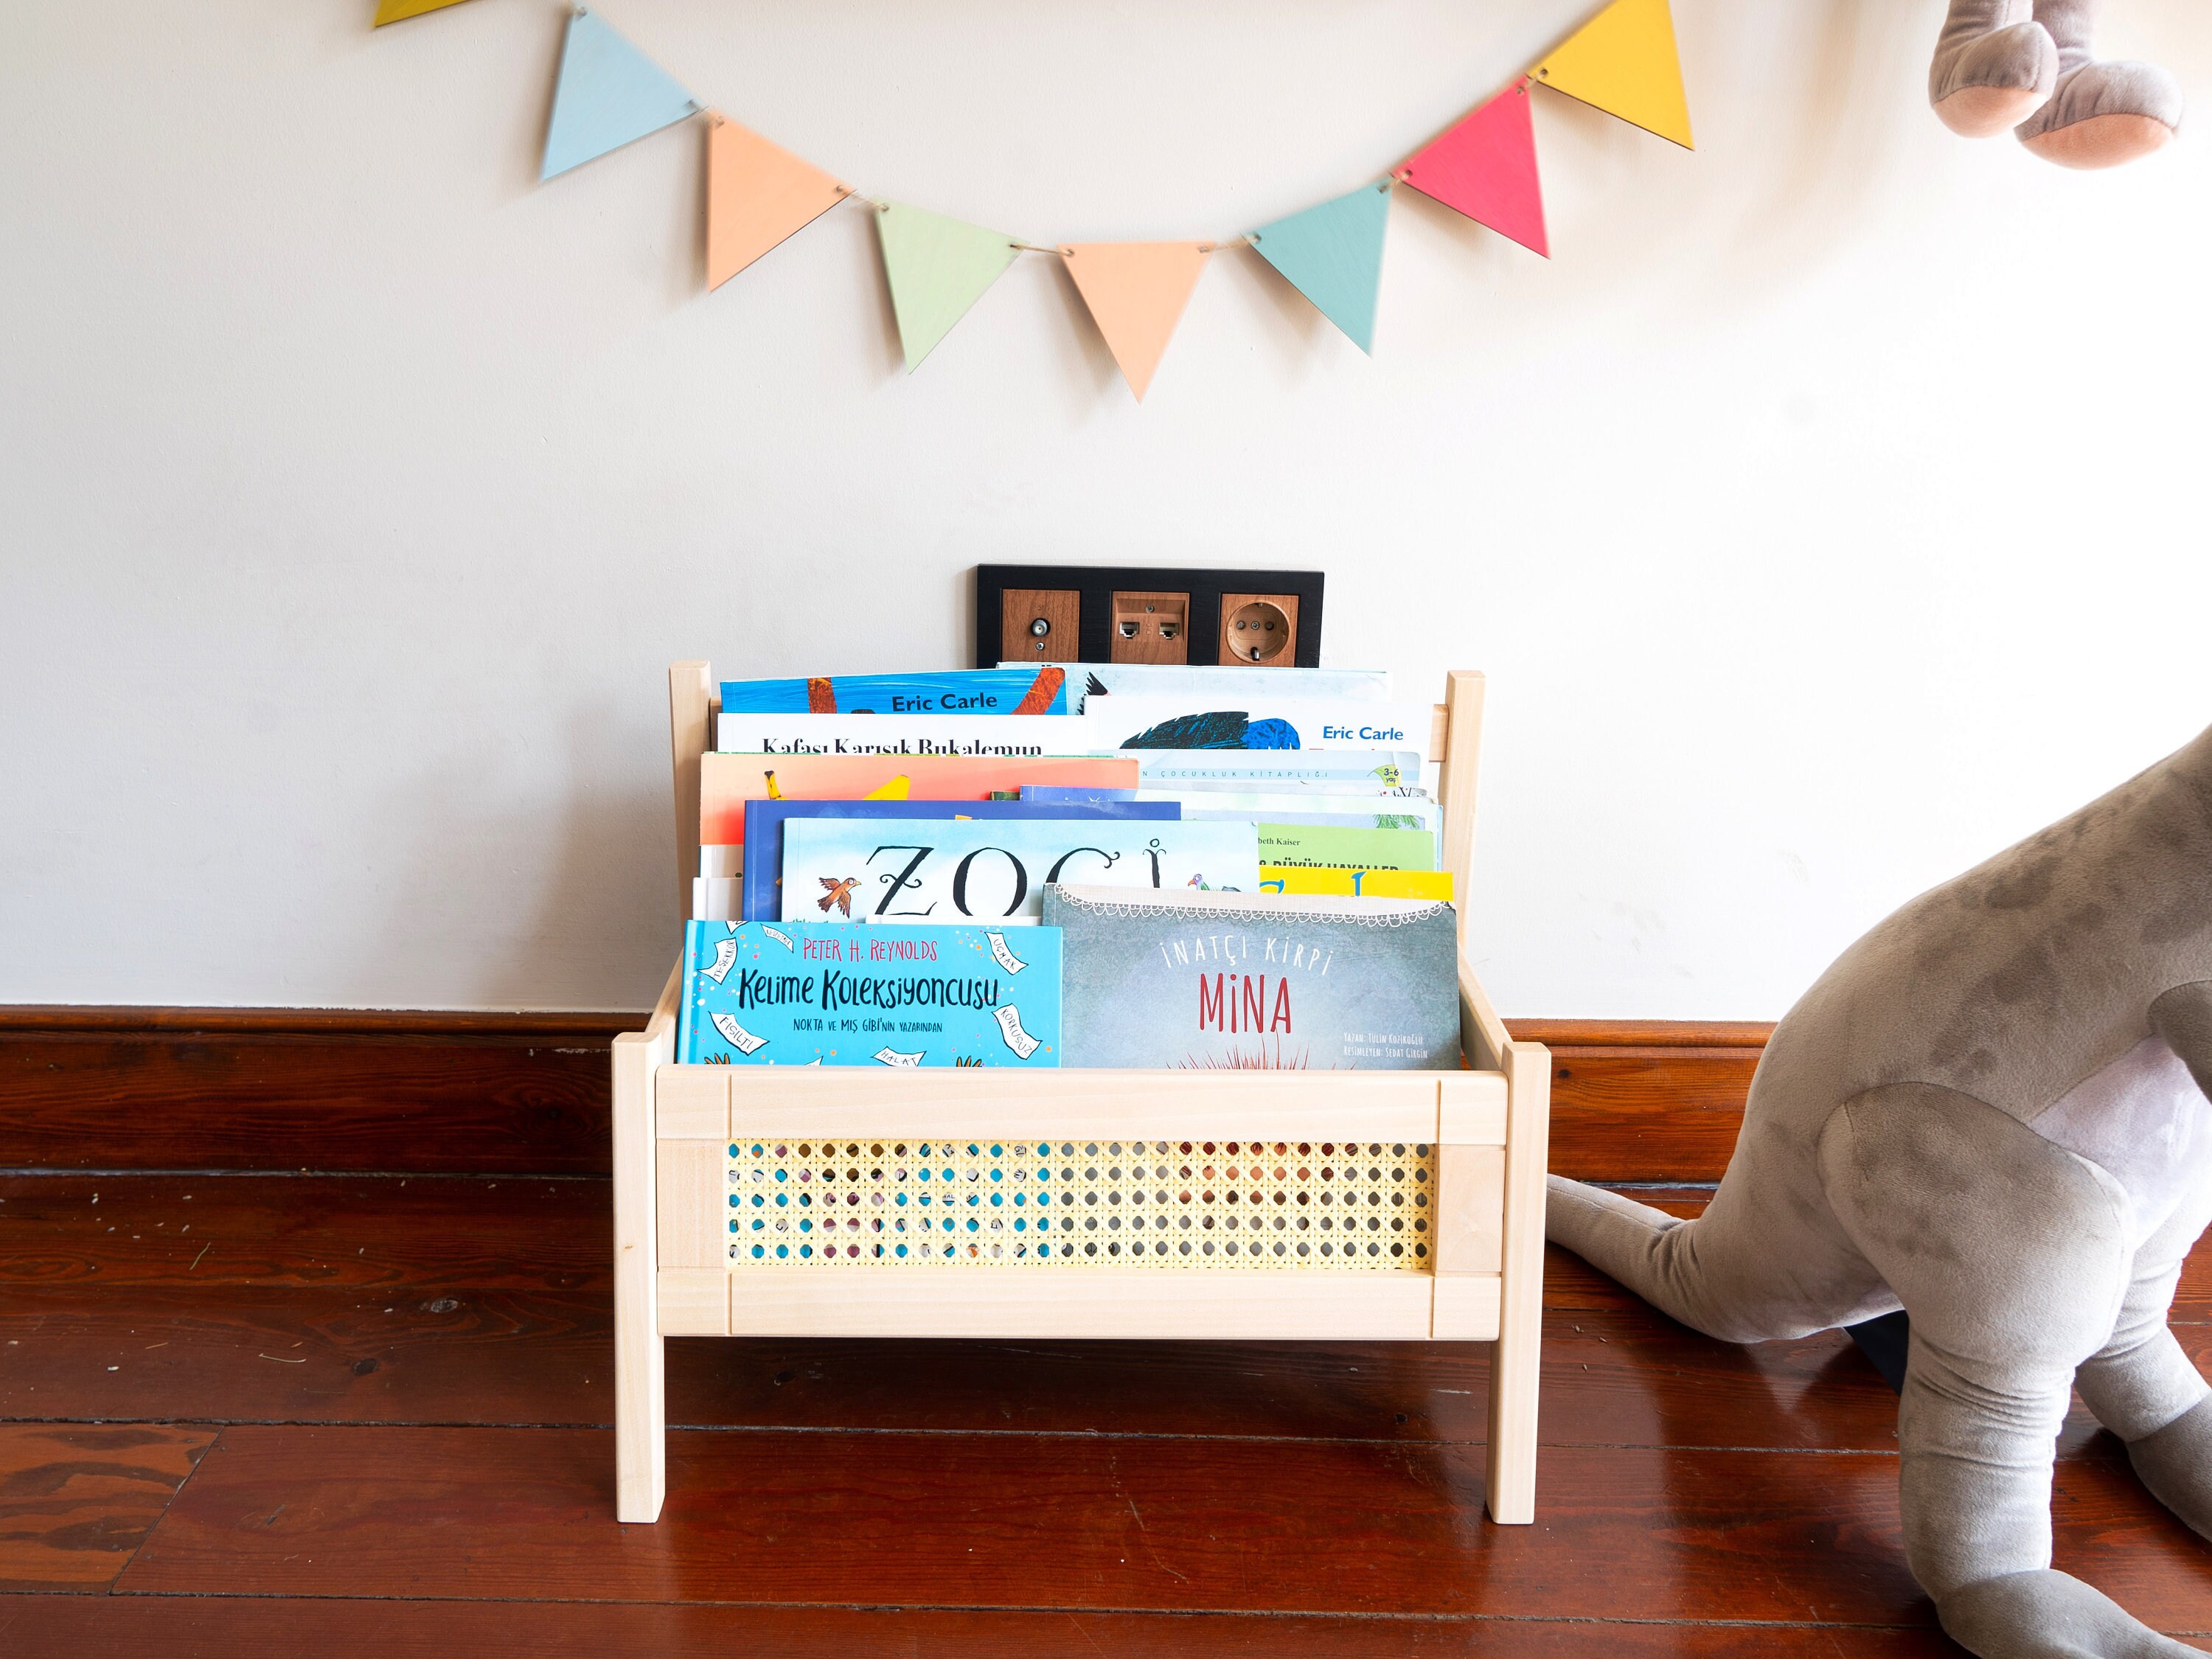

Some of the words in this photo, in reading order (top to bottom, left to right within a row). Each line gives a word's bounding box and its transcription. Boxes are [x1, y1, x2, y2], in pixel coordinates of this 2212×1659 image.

[892, 695, 933, 712] Eric
[940, 692, 998, 709] Carle
[1323, 726, 1354, 740] Eric
[1359, 727, 1404, 740] Carle
[1250, 770, 1327, 778] KİTAPLIĞI
[1384, 768, 1399, 776] 3-6
[1276, 838, 1301, 846] Kaiser
[804, 938, 842, 961] PETER
[849, 939, 864, 962] H.
[870, 939, 938, 961] REYNOLDS
[1159, 935, 1246, 967] İNATÇI
[1265, 936, 1334, 975] KİRPİ
[739, 967, 813, 1010] Kelime
[793, 1018, 824, 1032] NOKTA
[828, 1020, 837, 1032] VE
[841, 1019, 858, 1034] MIŞ
[899, 1021, 943, 1033] YAZARINDAN
